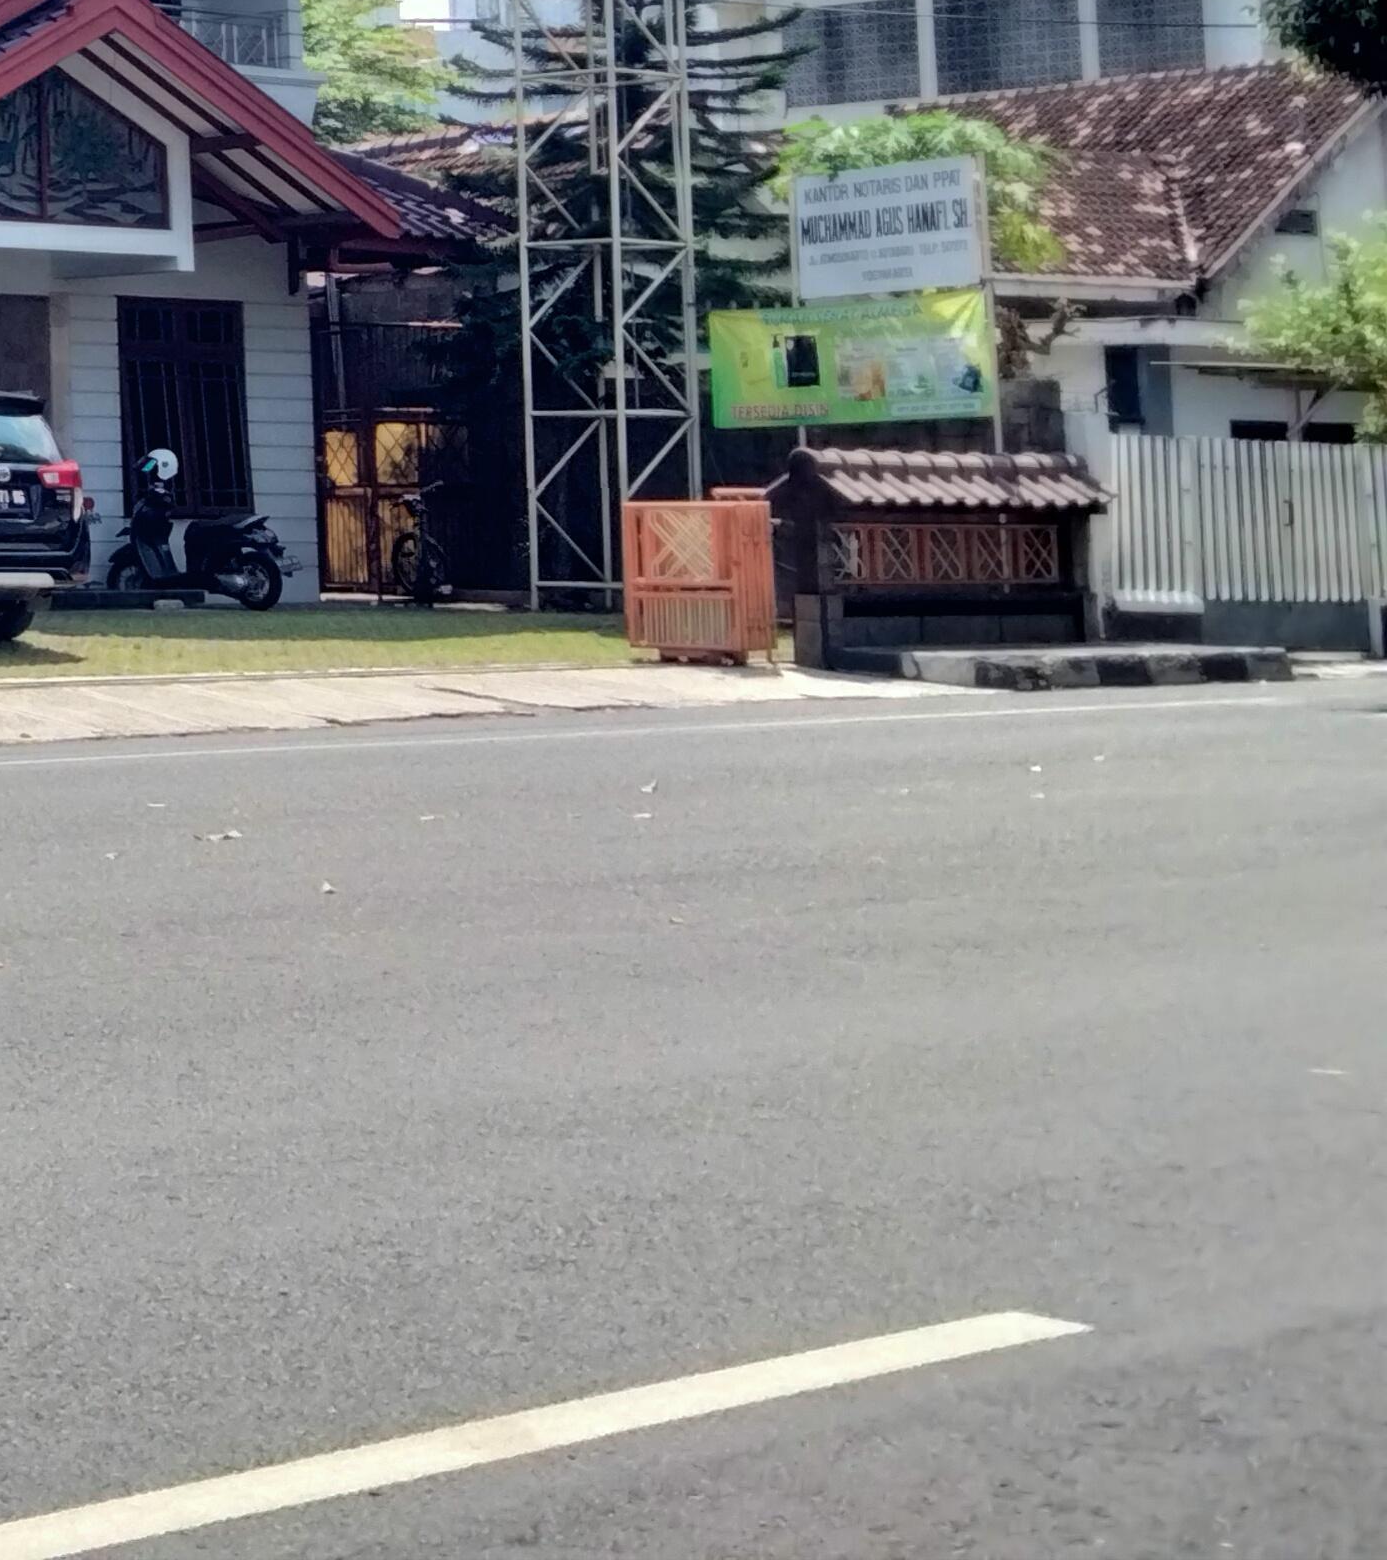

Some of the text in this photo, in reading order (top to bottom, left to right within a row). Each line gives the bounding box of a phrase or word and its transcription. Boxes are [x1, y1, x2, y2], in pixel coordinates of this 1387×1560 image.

[804, 169, 962, 204] KANTOR NOTARIS DAN PPAT
[800, 209, 872, 246] MUCHAMMAD
[875, 206, 904, 237] AGUS
